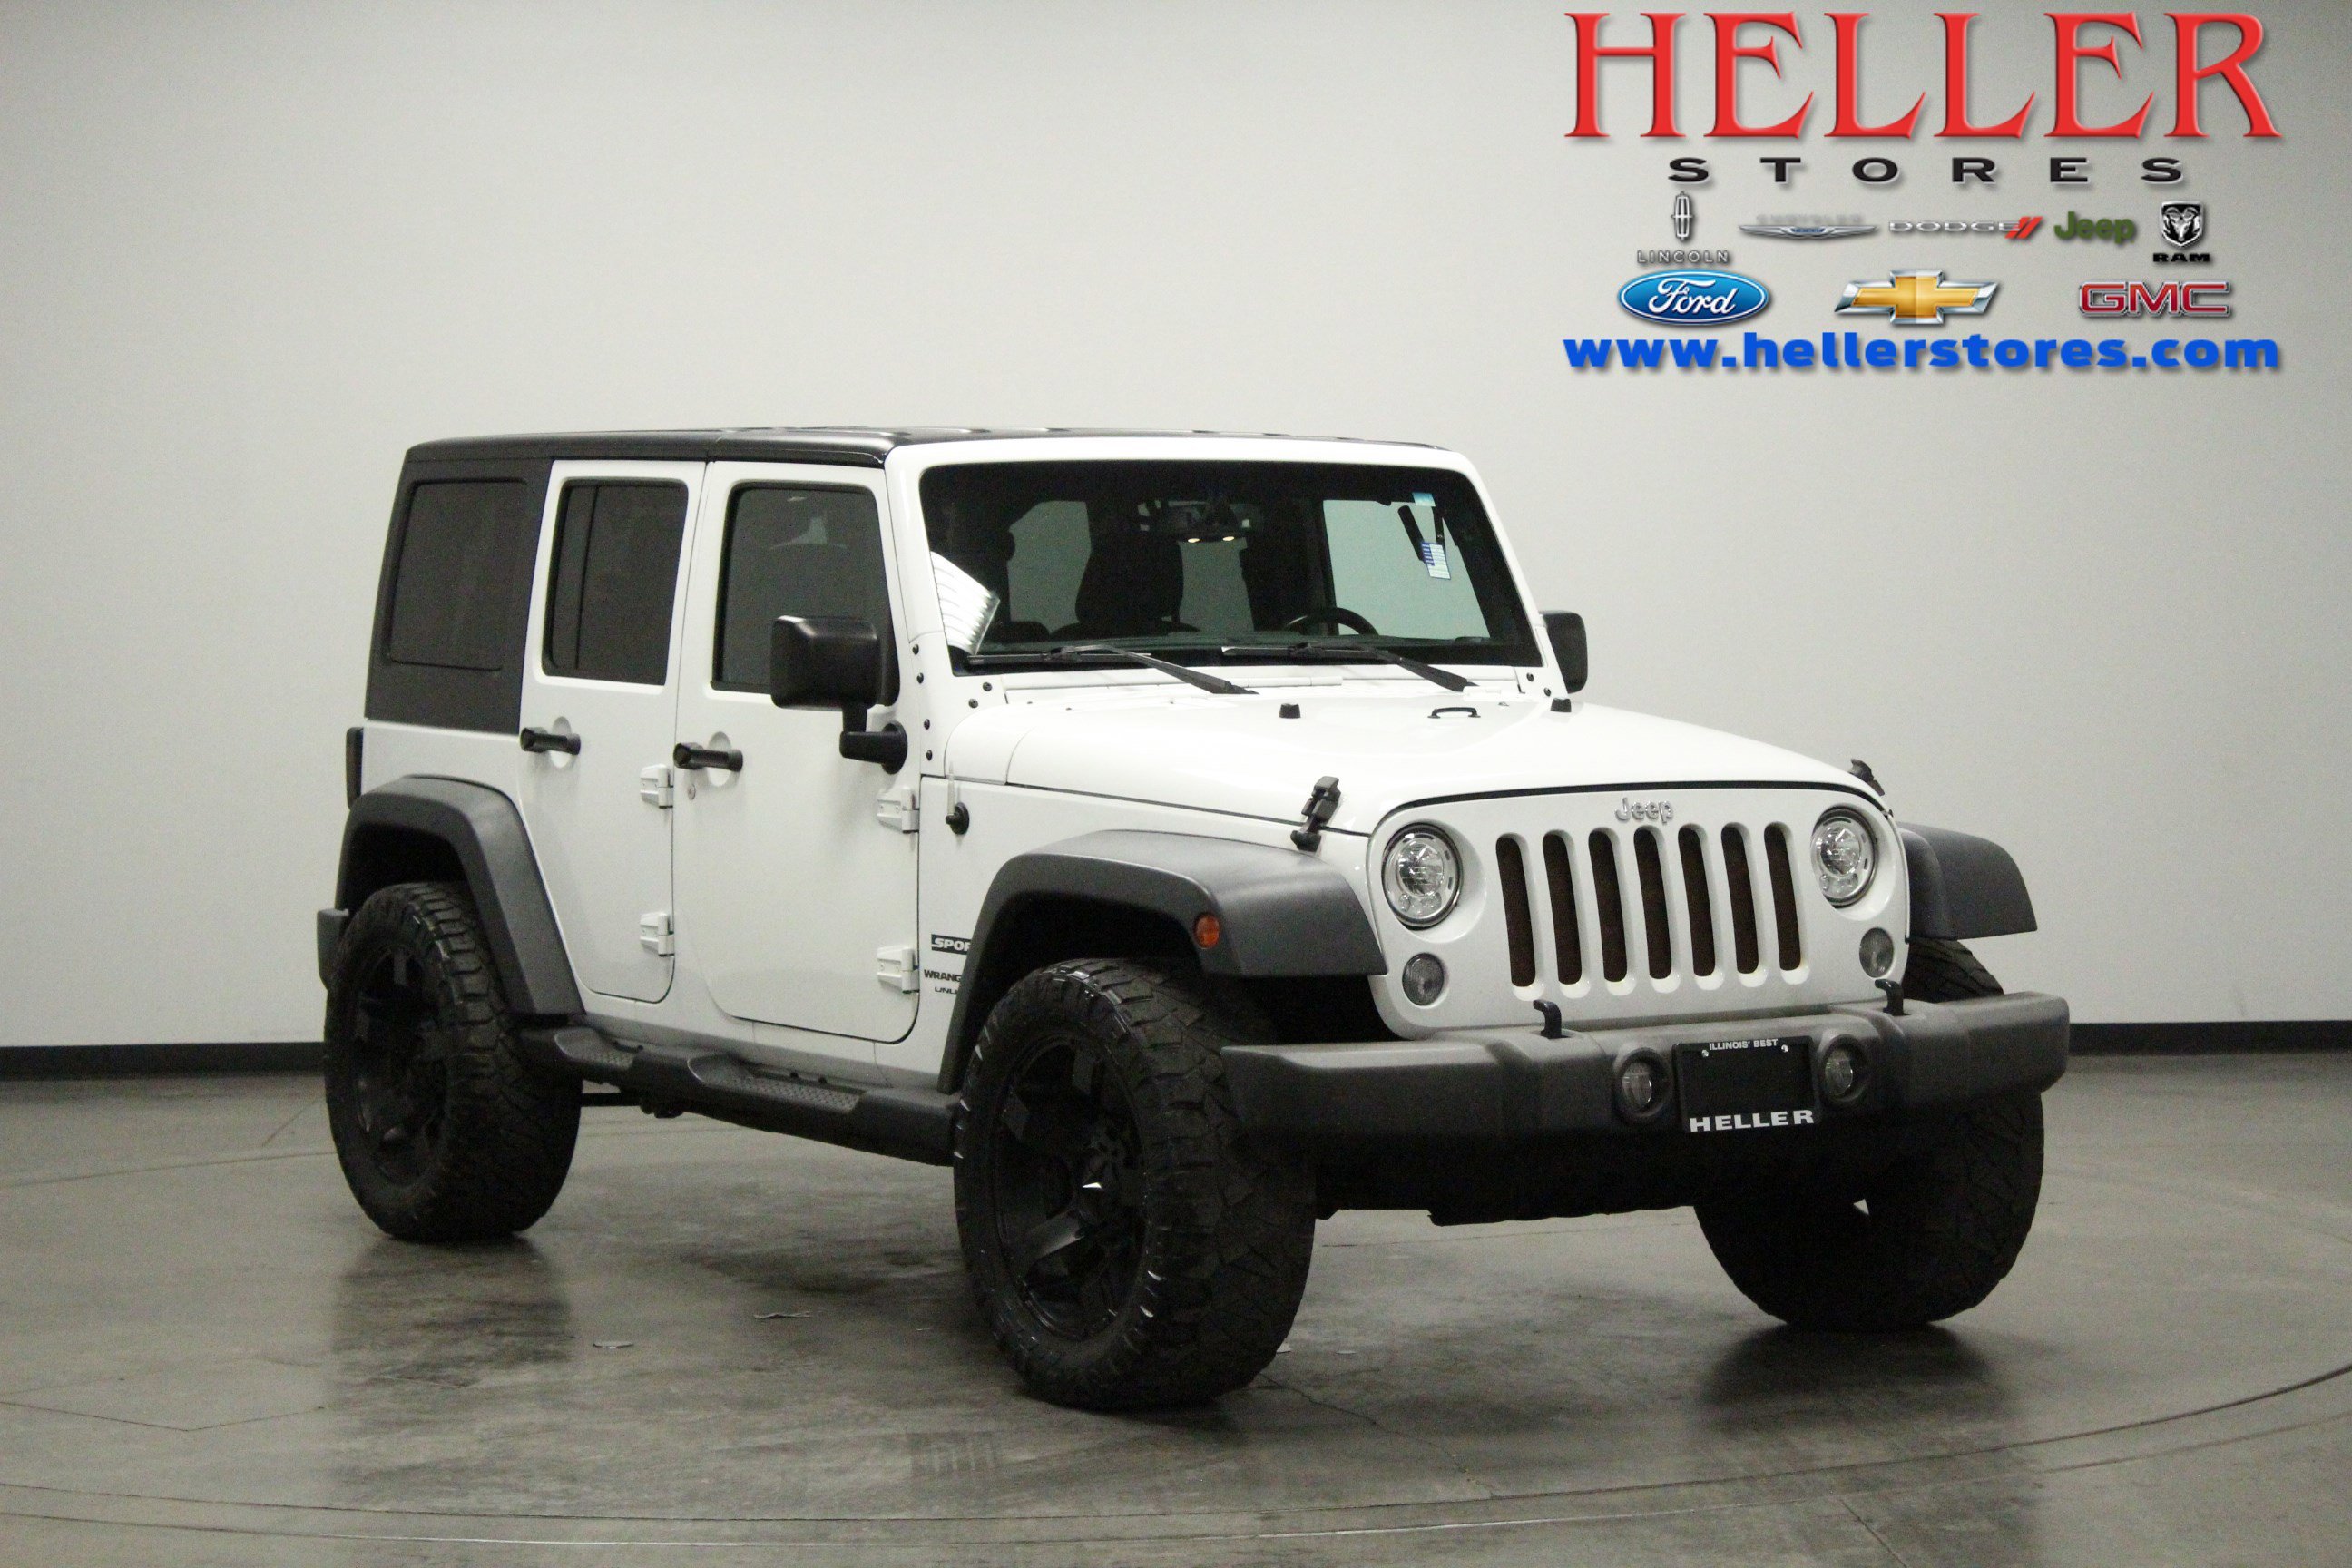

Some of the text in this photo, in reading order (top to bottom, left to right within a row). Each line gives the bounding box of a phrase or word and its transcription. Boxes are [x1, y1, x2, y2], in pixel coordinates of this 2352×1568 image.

[1615, 798, 1673, 825] Jeep
[1753, 1038, 1779, 1048] BEST
[1689, 1109, 1815, 1132] HELLER
